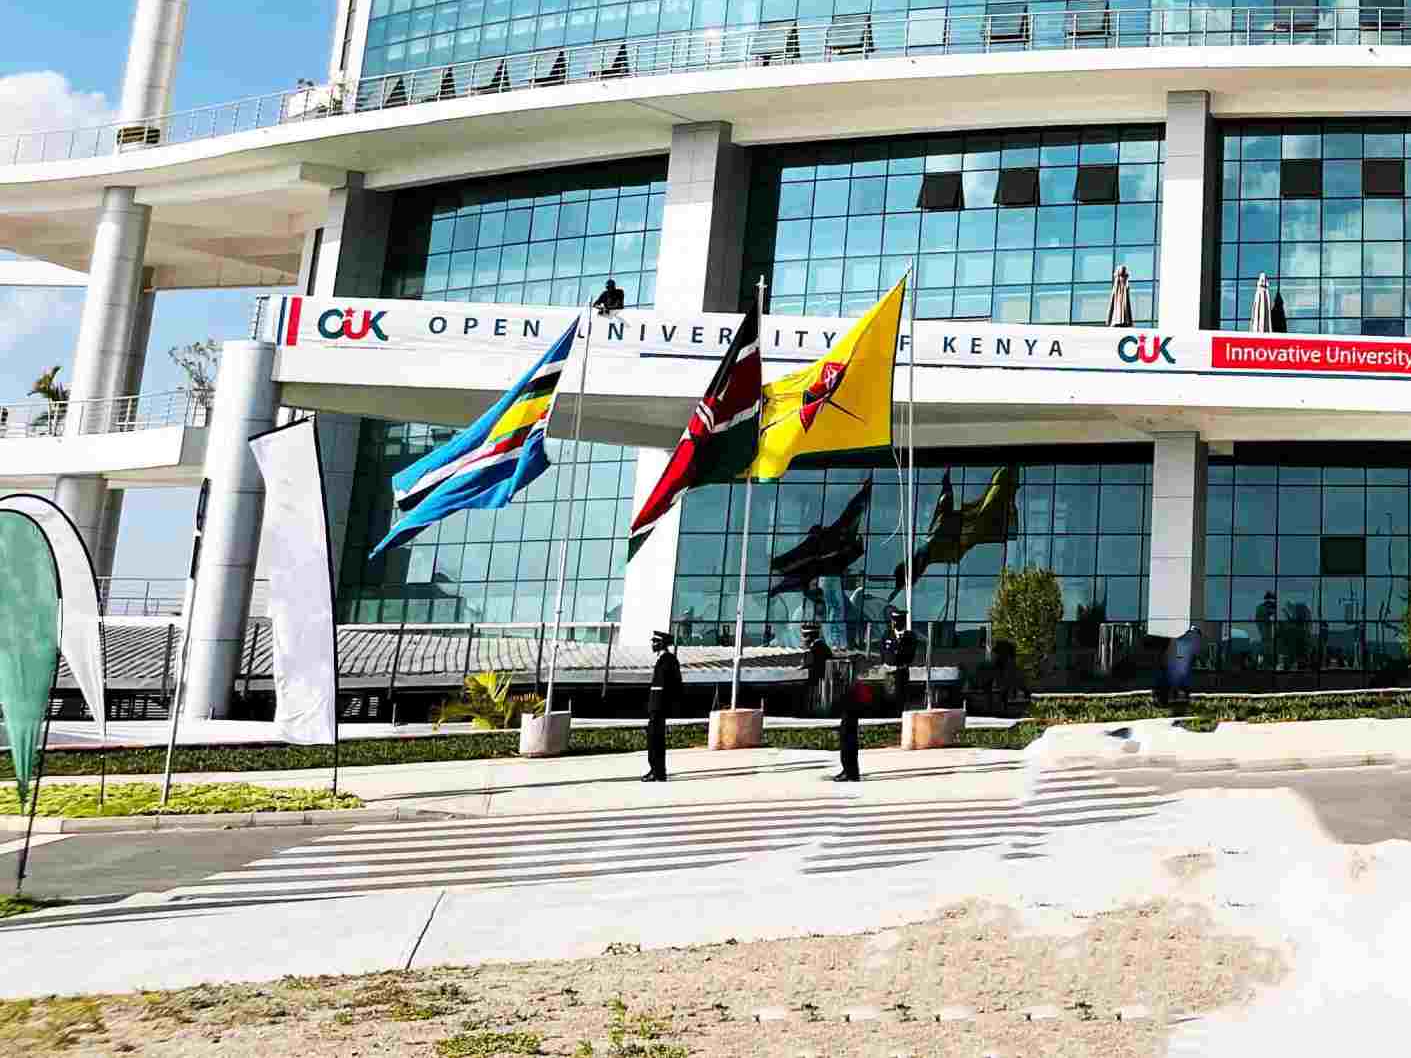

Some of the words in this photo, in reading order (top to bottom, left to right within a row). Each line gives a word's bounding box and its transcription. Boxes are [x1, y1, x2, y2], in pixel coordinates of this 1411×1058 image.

[428, 316, 541, 338] OPEN
[577, 322, 837, 349] NIVERITY
[943, 336, 1064, 357] KENYA
[1225, 343, 1321, 363] Innovative
